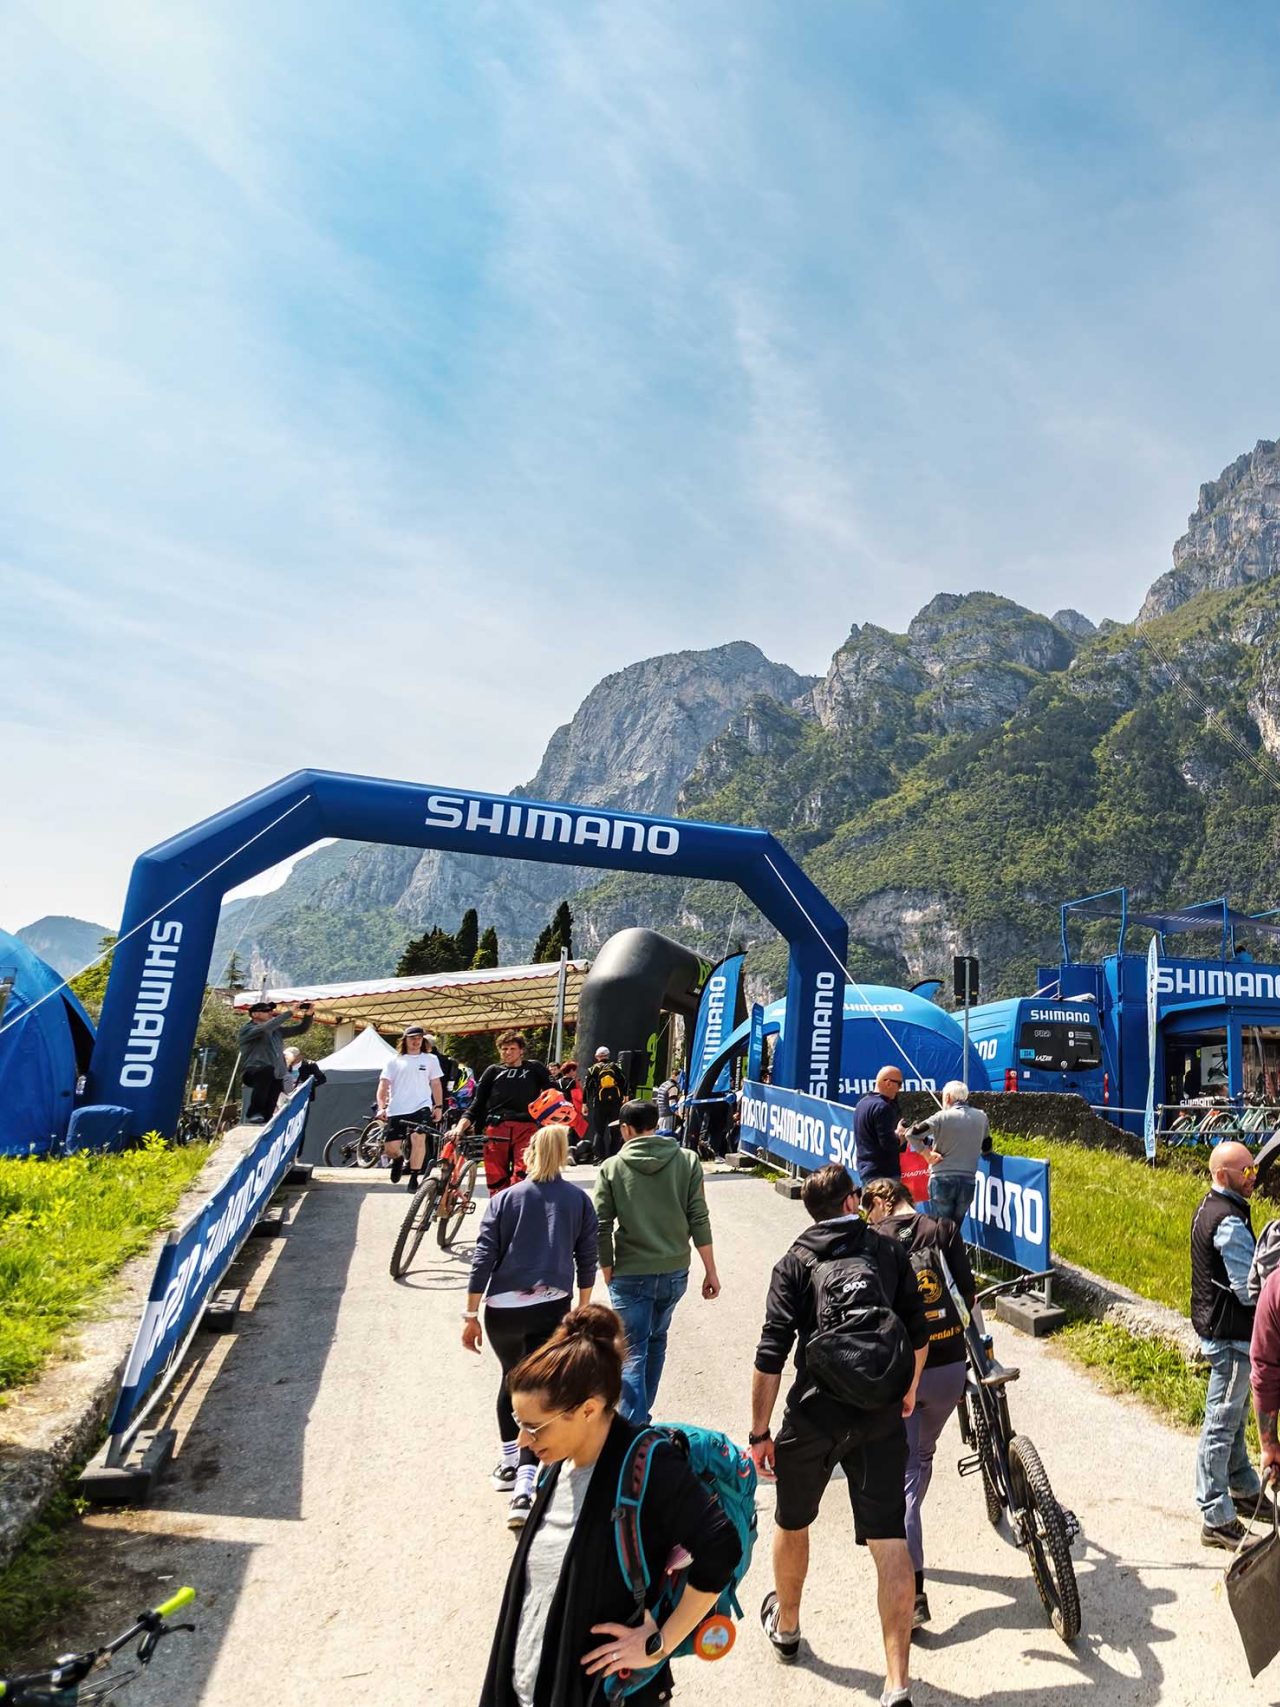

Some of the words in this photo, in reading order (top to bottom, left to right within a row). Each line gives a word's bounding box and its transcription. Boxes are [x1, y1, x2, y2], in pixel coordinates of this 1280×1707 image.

[425, 795, 680, 856] SHIMANO
[120, 920, 183, 1088] SHIMANO
[843, 1003, 904, 1013] HIMANO
[1030, 1009, 1090, 1023] SHIMANO
[810, 971, 836, 1099] SHIMANO
[769, 1104, 826, 1157] SHIMANO
[843, 1280, 867, 1293] evoc
